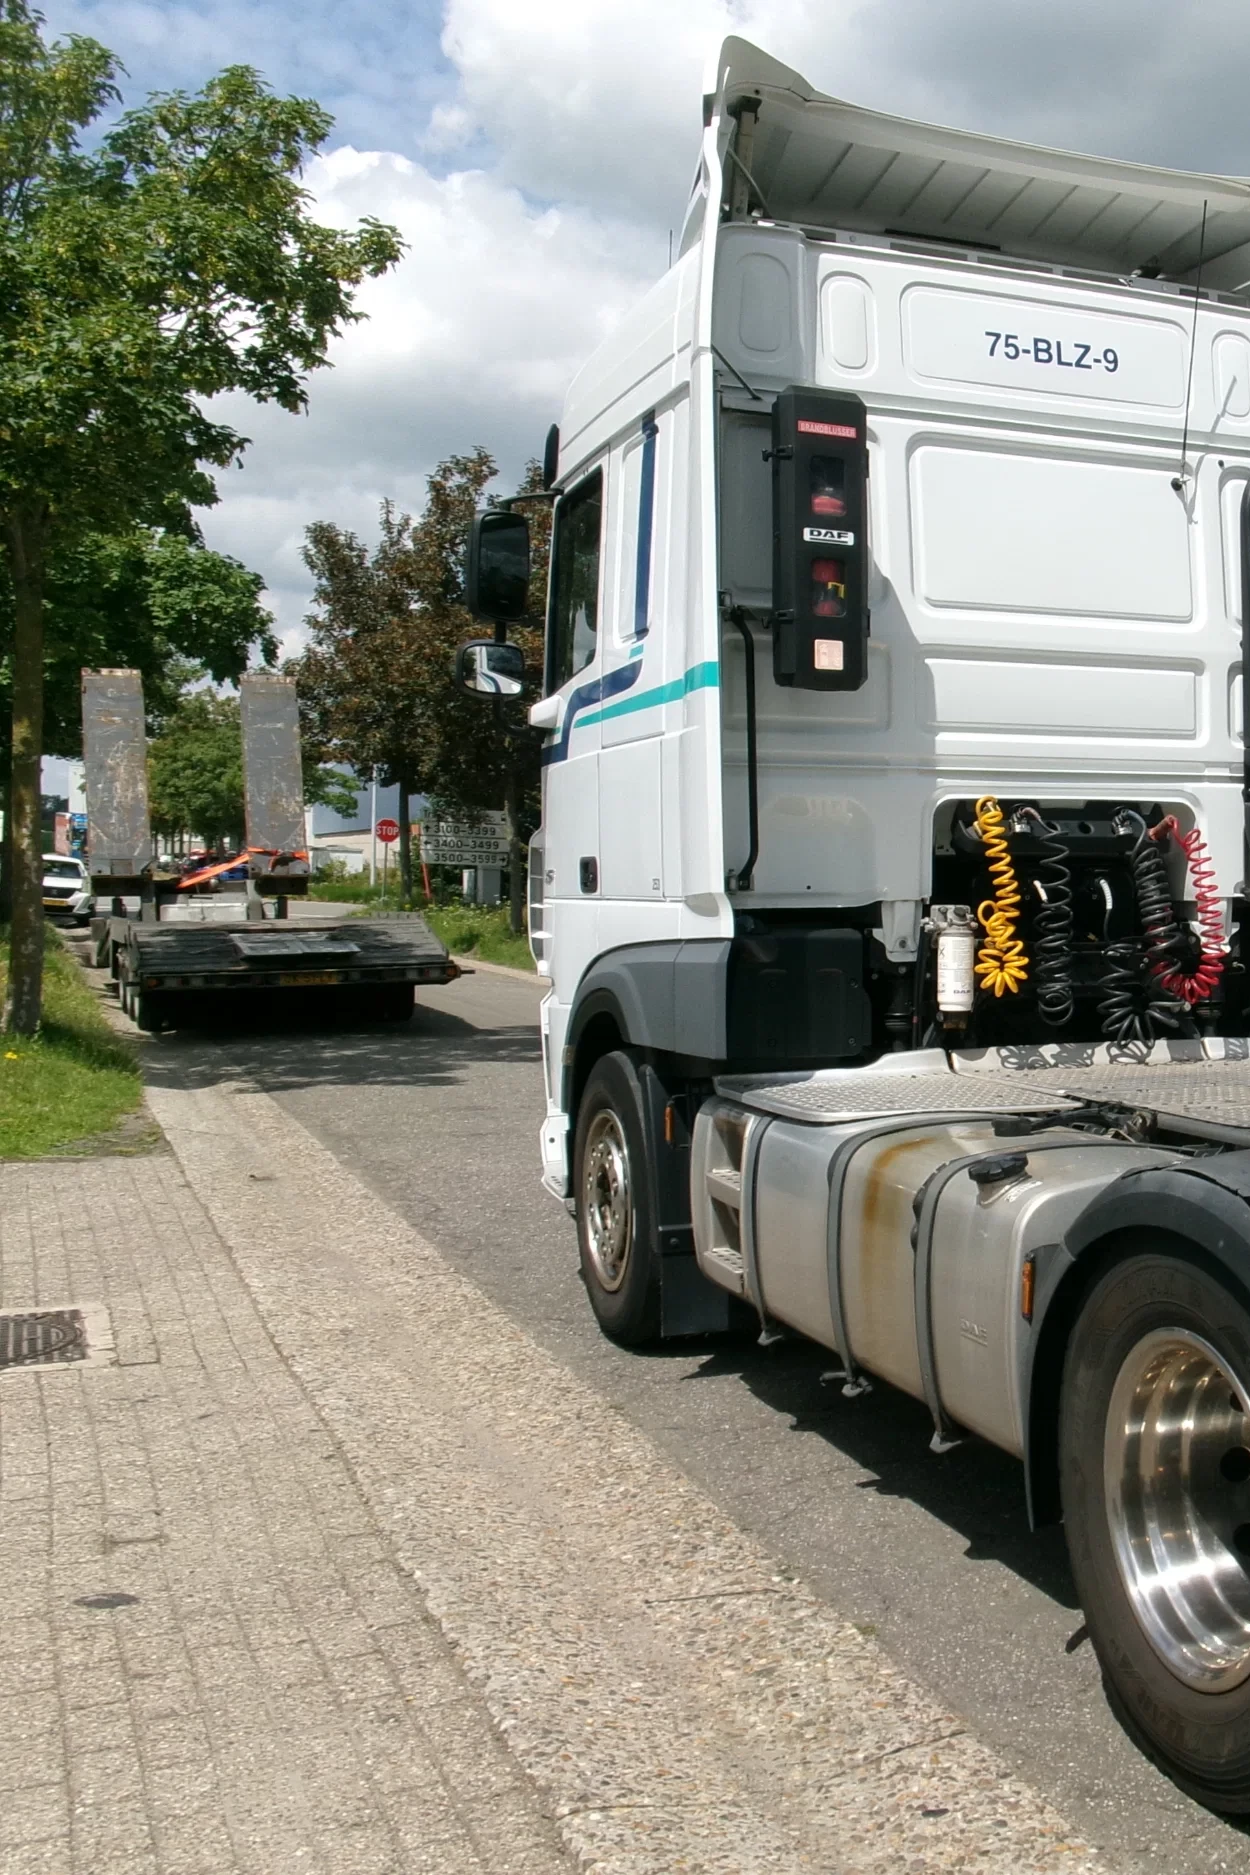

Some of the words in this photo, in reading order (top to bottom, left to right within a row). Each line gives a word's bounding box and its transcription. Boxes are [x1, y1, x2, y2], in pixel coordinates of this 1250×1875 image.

[985, 331, 1119, 373] 75-BLZ-9
[809, 530, 849, 539] DAF
[376, 826, 399, 834] STOP
[434, 839, 499, 849] 3400-3499
[434, 852, 497, 863] 3500-3599
